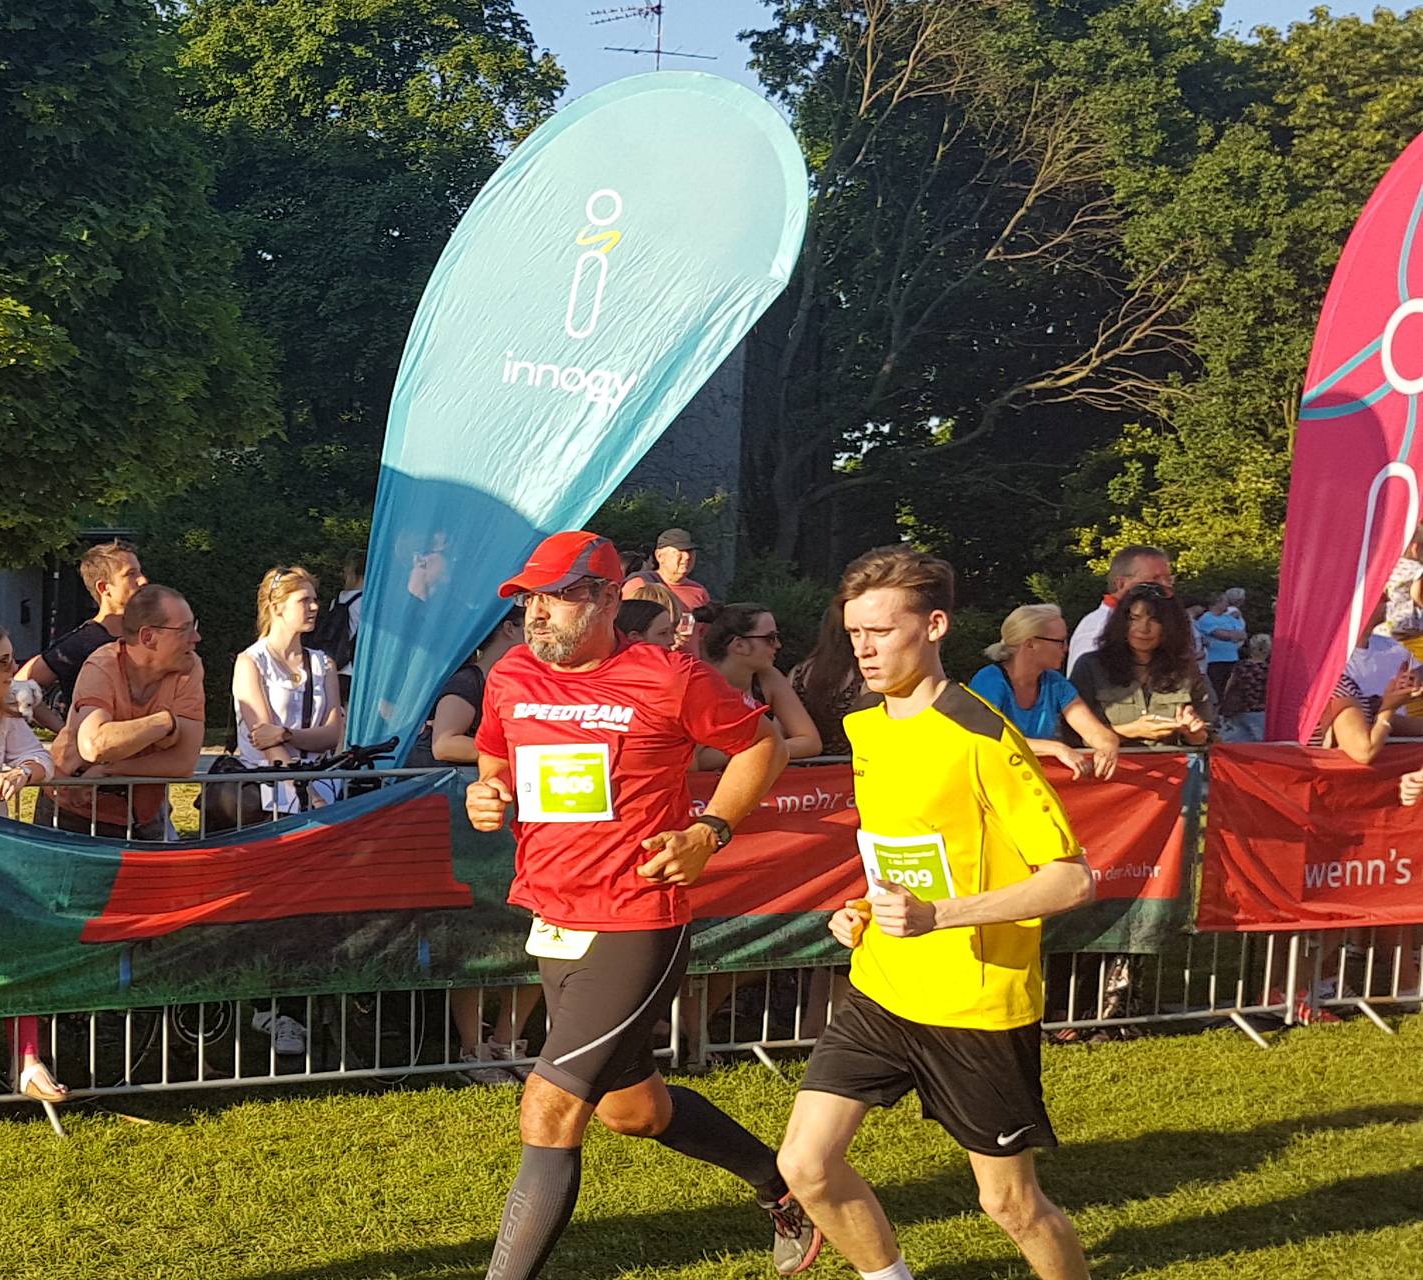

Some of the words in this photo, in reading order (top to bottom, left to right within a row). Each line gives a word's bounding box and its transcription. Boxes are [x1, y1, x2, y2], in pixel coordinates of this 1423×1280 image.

[501, 350, 638, 405] innogy
[513, 702, 634, 724] SPEEDTEAM
[776, 788, 842, 813] mehr
[1305, 848, 1412, 889] wenn's
